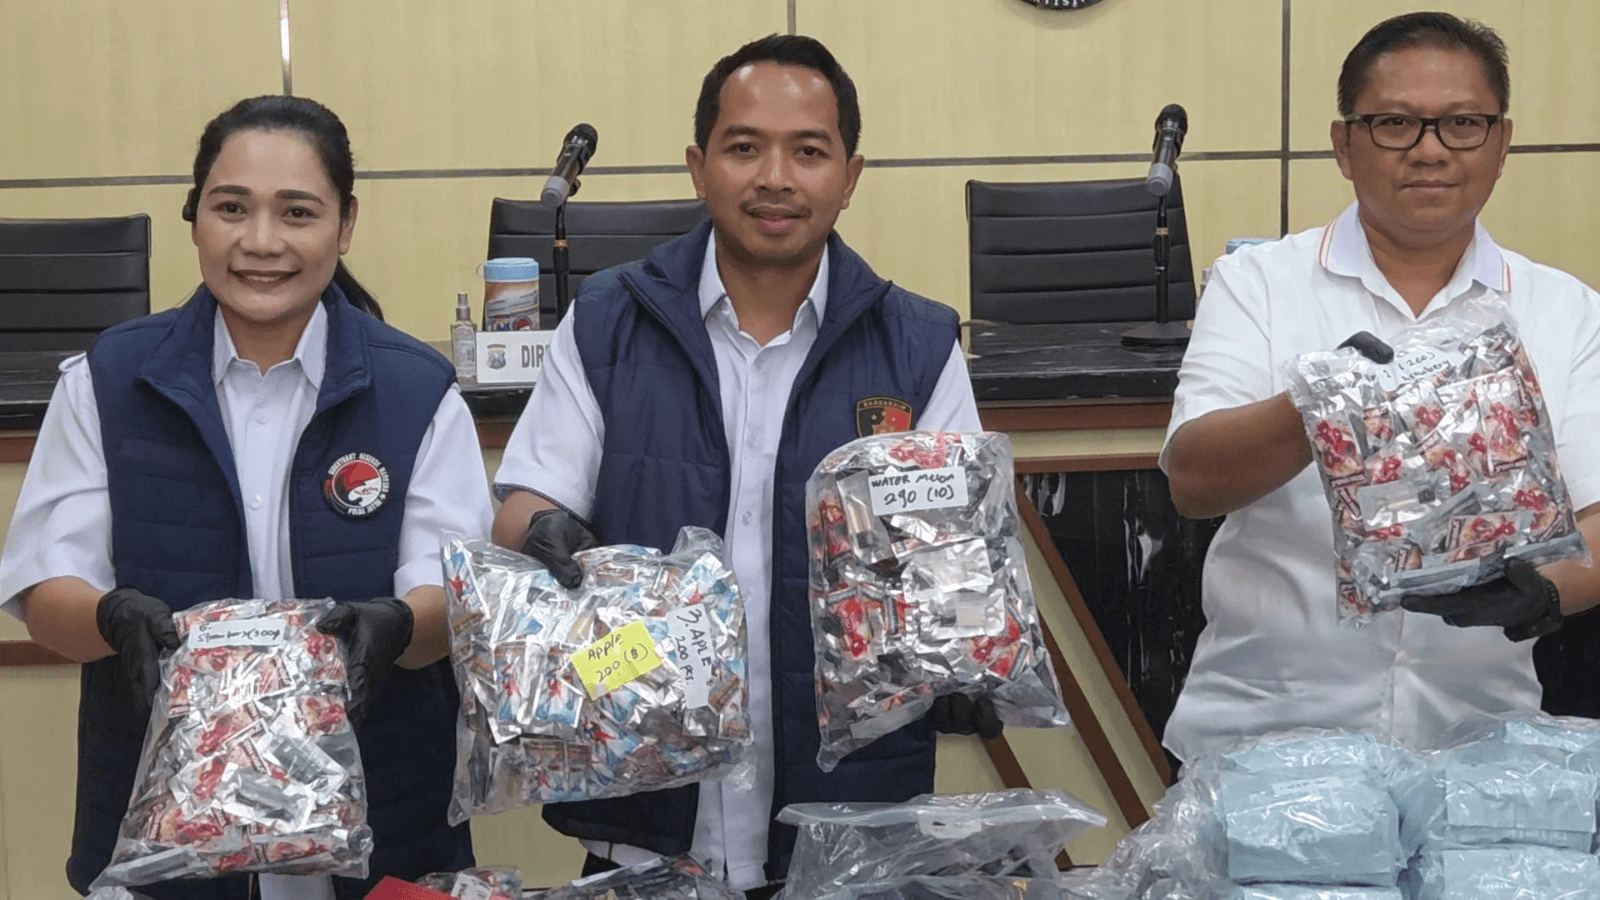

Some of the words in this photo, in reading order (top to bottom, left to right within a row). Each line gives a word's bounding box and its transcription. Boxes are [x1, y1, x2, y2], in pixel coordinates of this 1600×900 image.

[521, 344, 550, 368] DIR
[871, 474, 911, 487] WATER
[884, 488, 917, 508] 290
[927, 484, 954, 502] (10)
[674, 635, 689, 660] 200
[595, 660, 621, 683] 200
